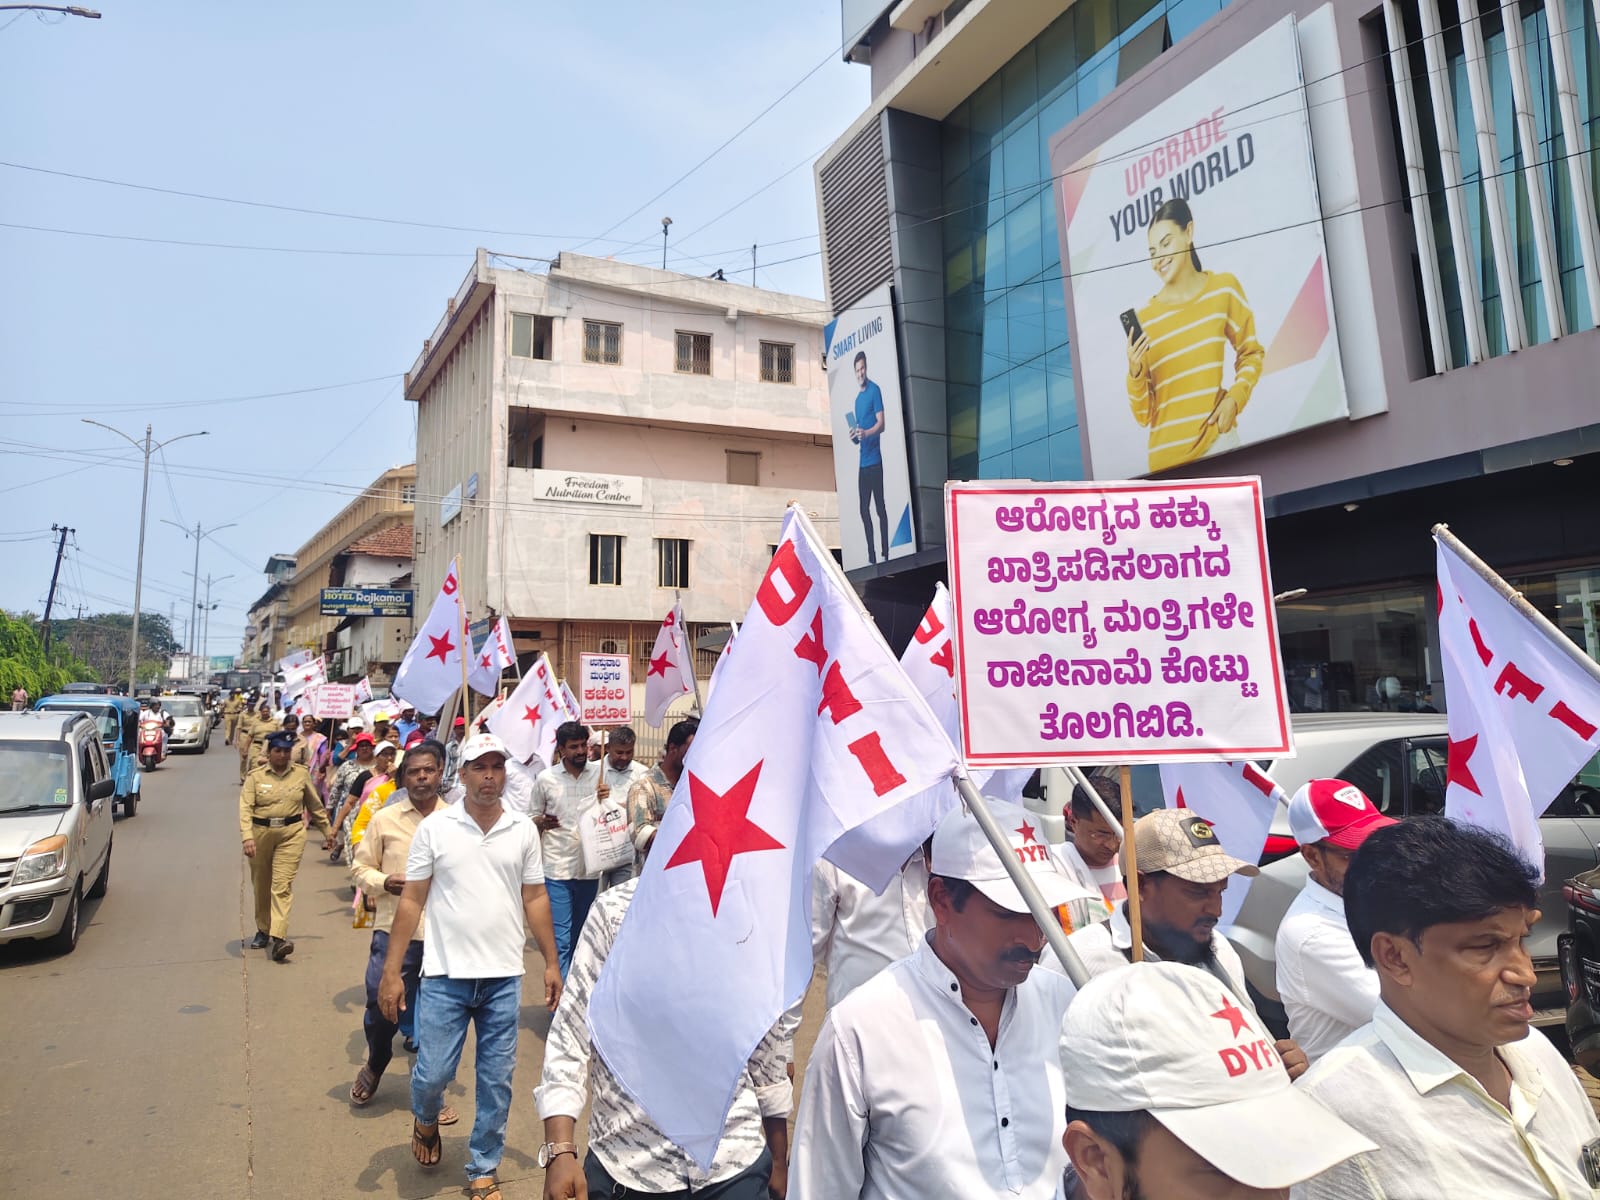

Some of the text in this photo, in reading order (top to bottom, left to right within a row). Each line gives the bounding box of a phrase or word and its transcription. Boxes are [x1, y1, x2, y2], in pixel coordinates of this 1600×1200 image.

[1124, 105, 1228, 197] UPGRADE
[1109, 132, 1255, 242] YOUR WORLD
[832, 316, 883, 361] SMART LIVING
[545, 486, 632, 502] Nutrition Centre
[564, 476, 609, 489] Freedom
[995, 495, 1222, 545] ಆರೋಗ್ಯದ ಹಕ್ಕು
[986, 544, 1231, 592] ಖಾತ್ರಿಪಡಿಸಲಾಗದ
[324, 592, 355, 601] HOTEL
[973, 593, 1254, 649] ಆರೋಗ್ಯ ಮಂತ್ರಿಗಳೇ
[584, 686, 625, 700] ಕಚೇರಿ
[986, 647, 1259, 698] ರಾಜೀನಾಮೆ ಕೊಟ್ಟು
[584, 705, 627, 719] ಚಲೋ
[1039, 701, 1204, 741] ತೊಲಗಿಬಿಡಿ.
